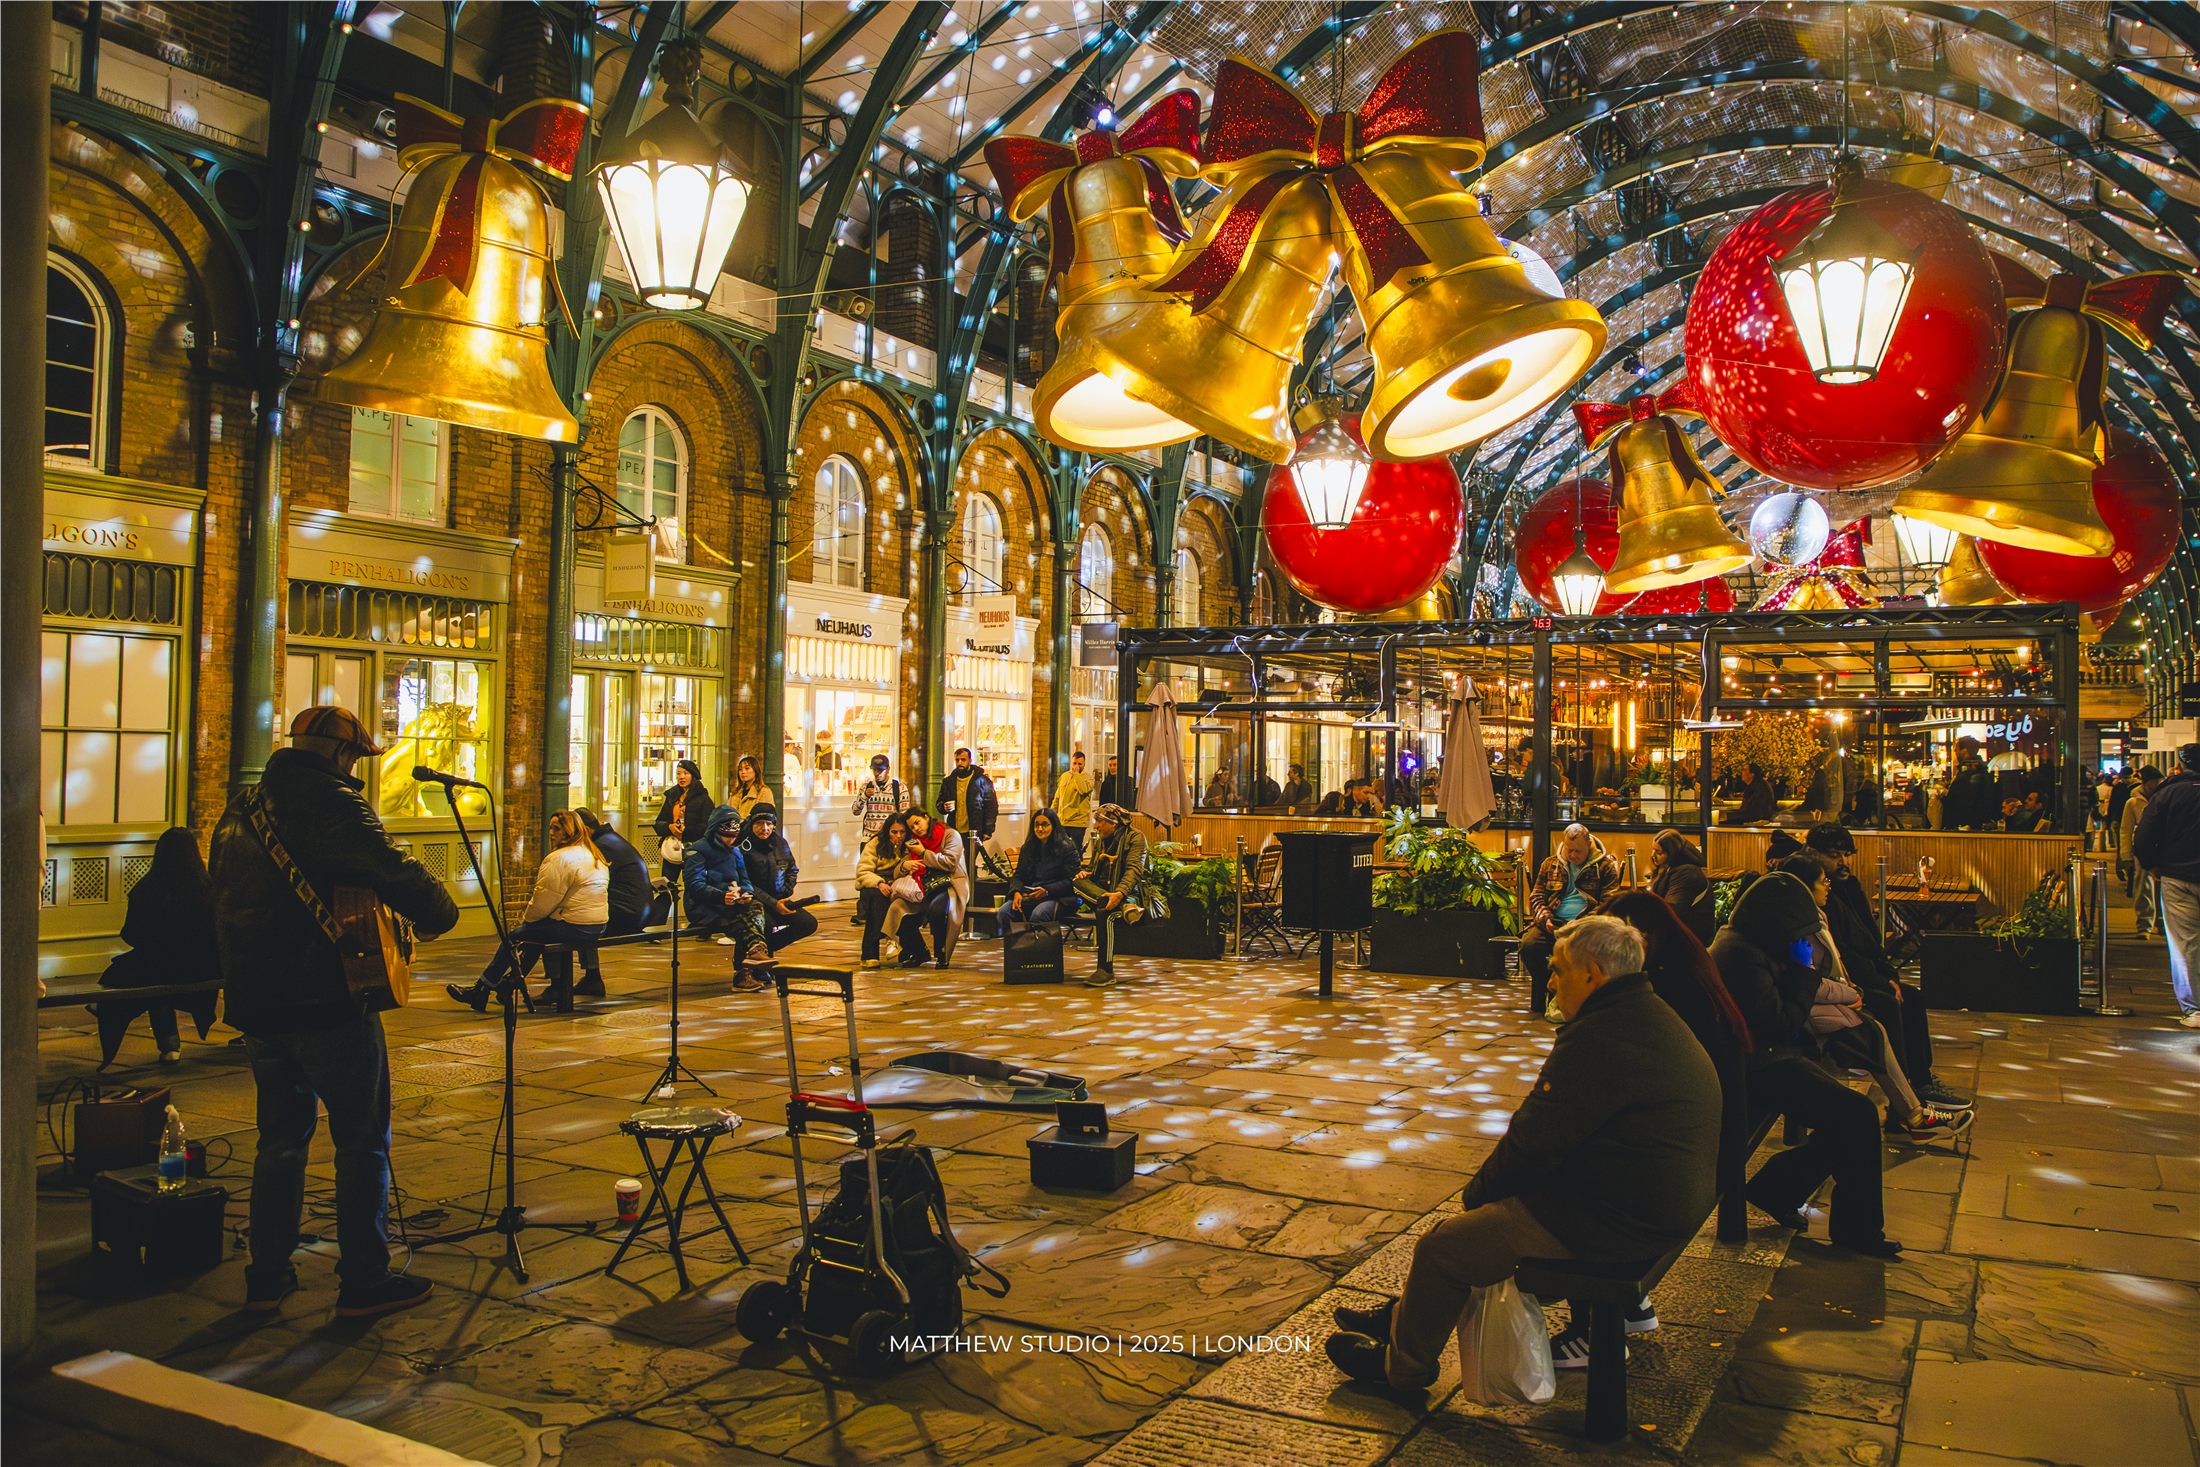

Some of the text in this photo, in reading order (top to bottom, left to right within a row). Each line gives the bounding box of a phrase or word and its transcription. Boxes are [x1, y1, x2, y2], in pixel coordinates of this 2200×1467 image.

[329, 560, 470, 591] PENHALIGON'S
[979, 611, 1011, 624] NEUHAUS
[816, 618, 873, 638] NEUHAUS
